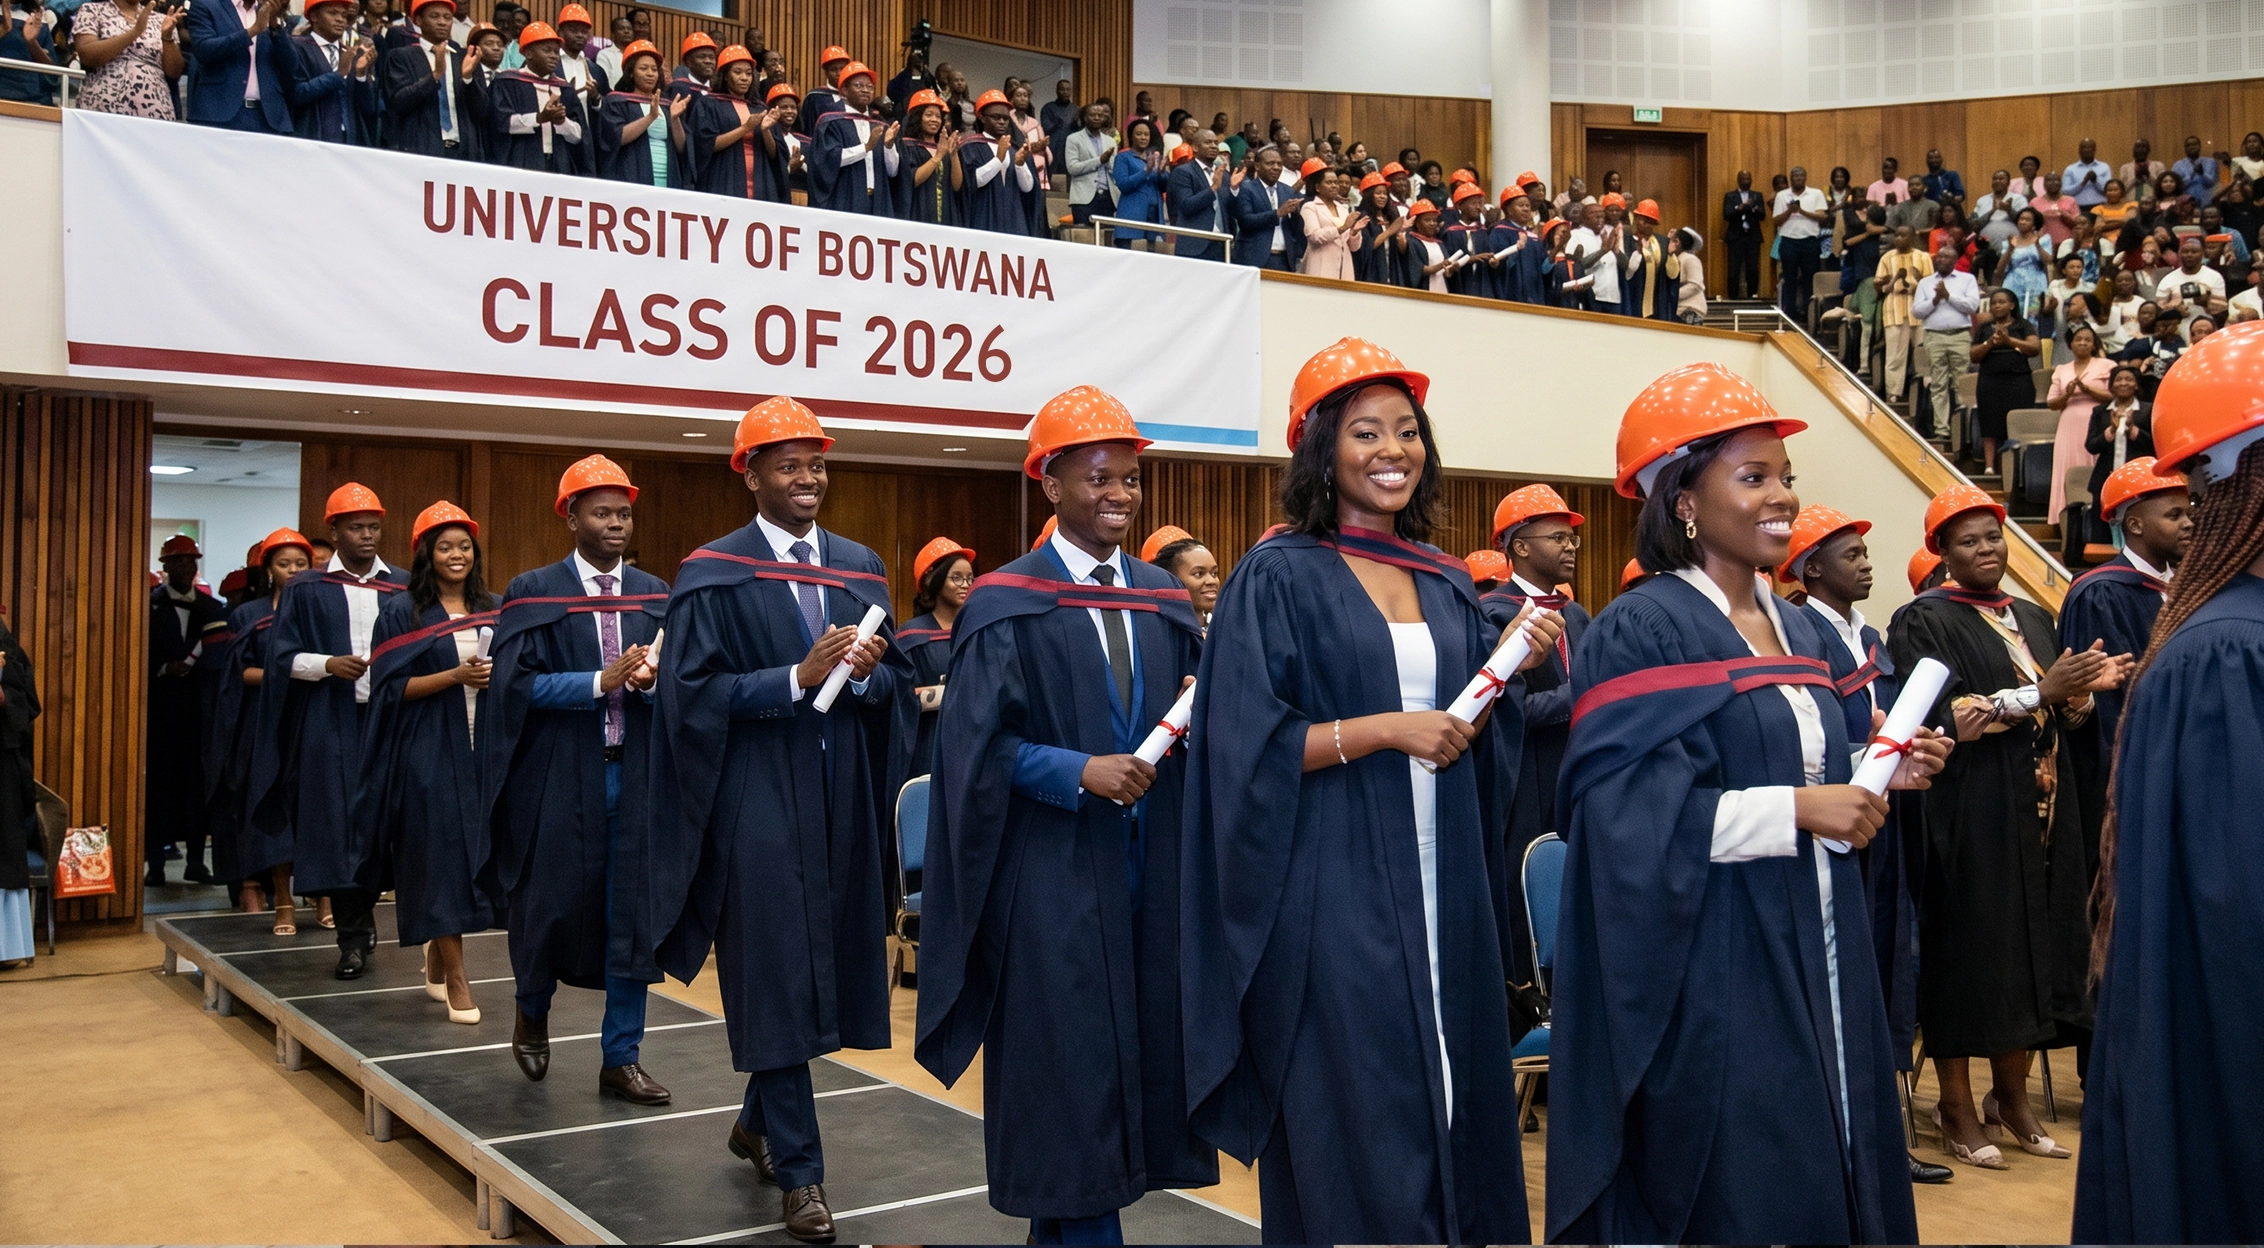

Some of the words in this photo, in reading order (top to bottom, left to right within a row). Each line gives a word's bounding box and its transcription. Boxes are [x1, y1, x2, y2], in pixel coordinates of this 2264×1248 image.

[424, 181, 730, 263] UNIVERSITY
[745, 222, 800, 271] OF
[818, 230, 1055, 301] BOTSWANA
[482, 277, 728, 360] CLASS
[755, 304, 841, 369] OF
[864, 315, 1012, 382] 2026
